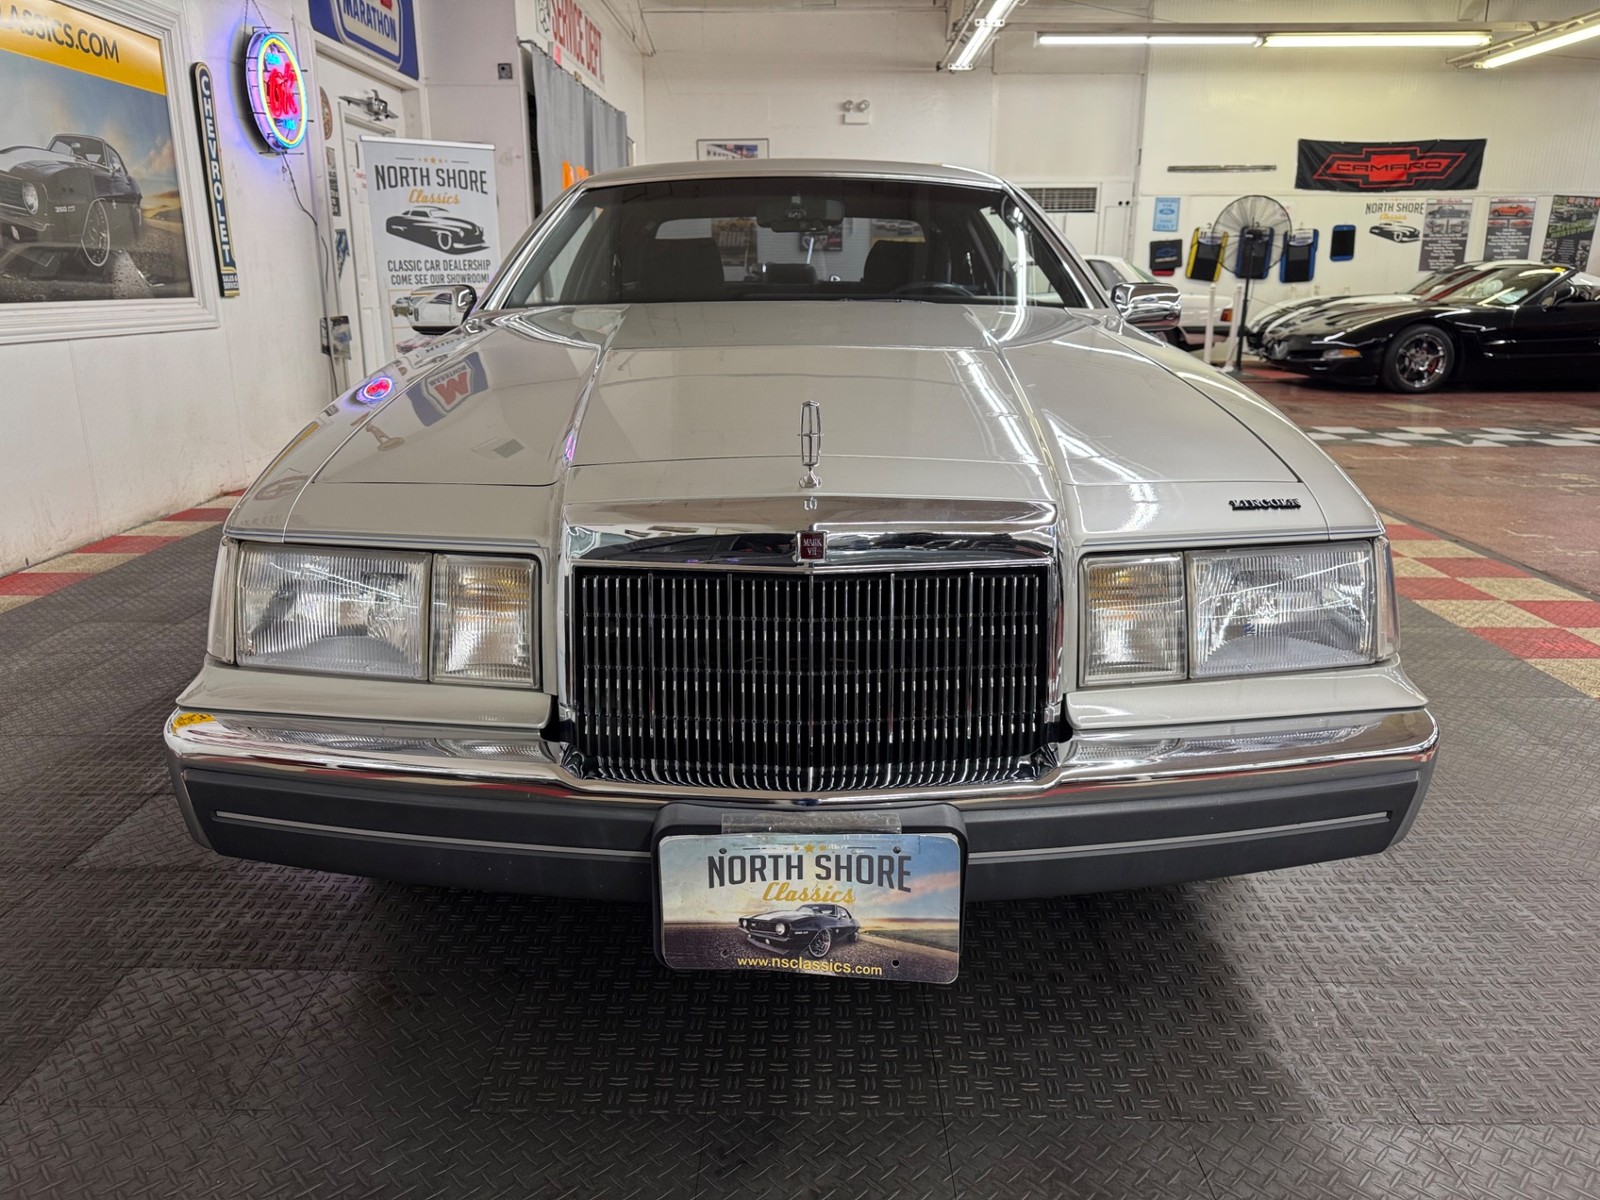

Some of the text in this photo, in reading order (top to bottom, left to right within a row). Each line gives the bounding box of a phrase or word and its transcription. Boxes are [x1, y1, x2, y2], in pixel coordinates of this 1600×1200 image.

[343, 0, 397, 42] MARATHON
[200, 75, 230, 263] CHEVROLET
[1336, 161, 1442, 172] CAMARO
[374, 165, 430, 191] NORTH
[436, 168, 488, 195] SHORE
[408, 189, 460, 205] Classics
[1365, 202, 1425, 215] NORTH SHORE
[387, 259, 491, 272] CLASSIC CAR DEALERSHIP
[391, 273, 490, 285] COME SEE OUR SHOWROOM!
[803, 538, 822, 547] MARK
[707, 854, 911, 893] NORTH SHORE
[762, 881, 855, 904] Classics
[737, 957, 883, 976] www.nsclassics.com
